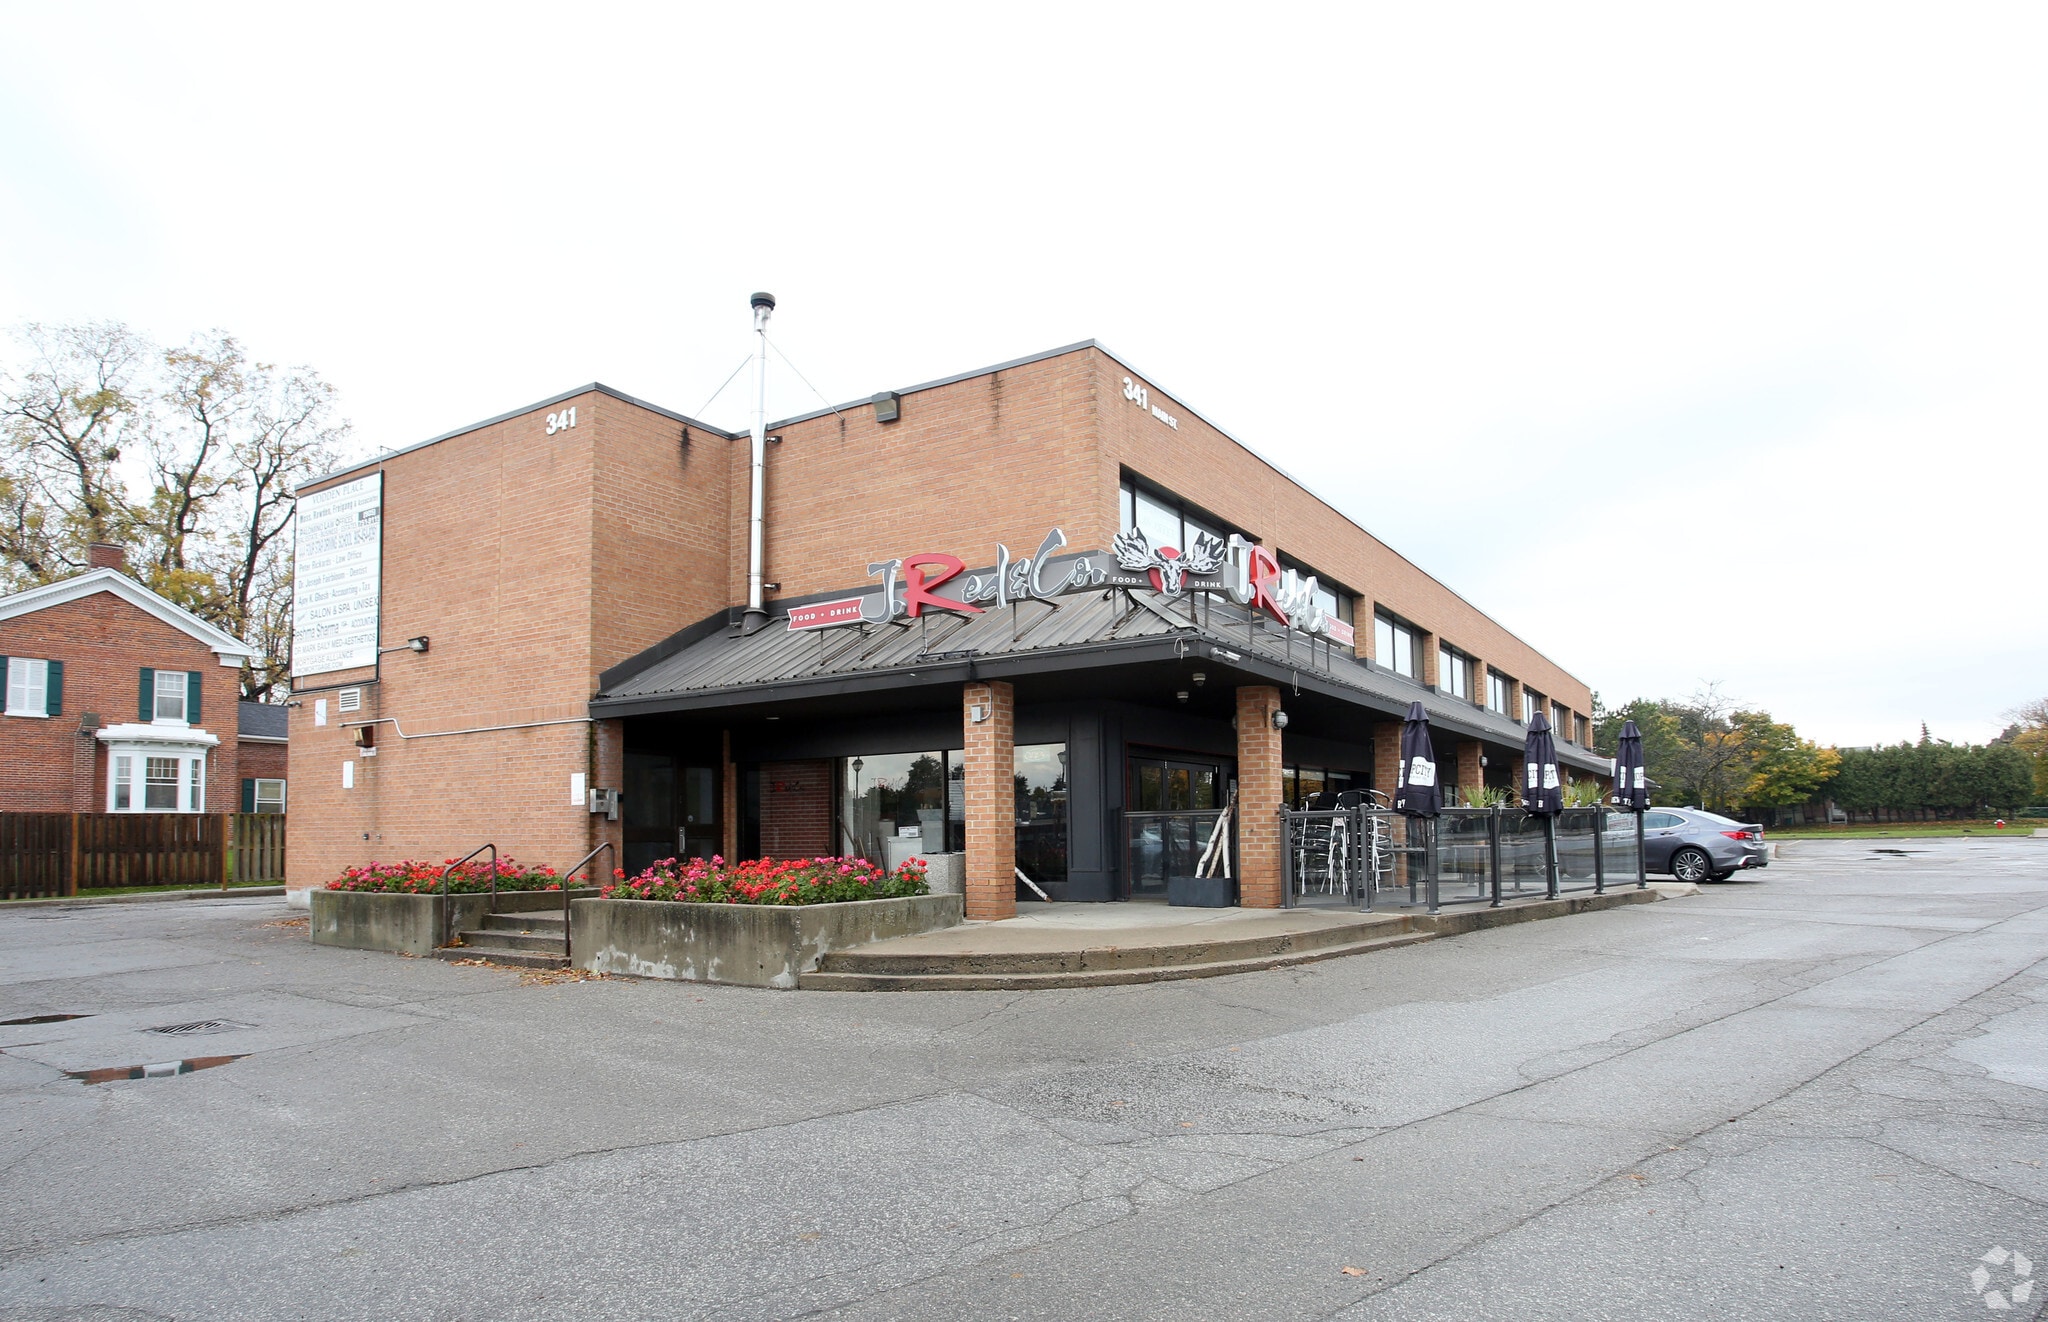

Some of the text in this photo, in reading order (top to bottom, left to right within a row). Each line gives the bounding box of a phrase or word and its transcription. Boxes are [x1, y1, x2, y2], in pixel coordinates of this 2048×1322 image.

[1123, 376, 1148, 410] 341
[546, 406, 576, 435] 341
[343, 481, 364, 495] PLACE
[347, 549, 362, 561] Office
[306, 577, 321, 588] Joseph
[350, 564, 367, 577] Dentist
[1112, 576, 1221, 588] FOOD DRINK
[332, 586, 358, 598] Accounting
[310, 607, 331, 620] SALON
[338, 603, 350, 614] SPA
[354, 596, 378, 610] UNISEX
[793, 606, 858, 623] FOOD DRINK
[317, 623, 339, 637] Sharma
[295, 650, 353, 667] MORTGAGE ALLIANCE
